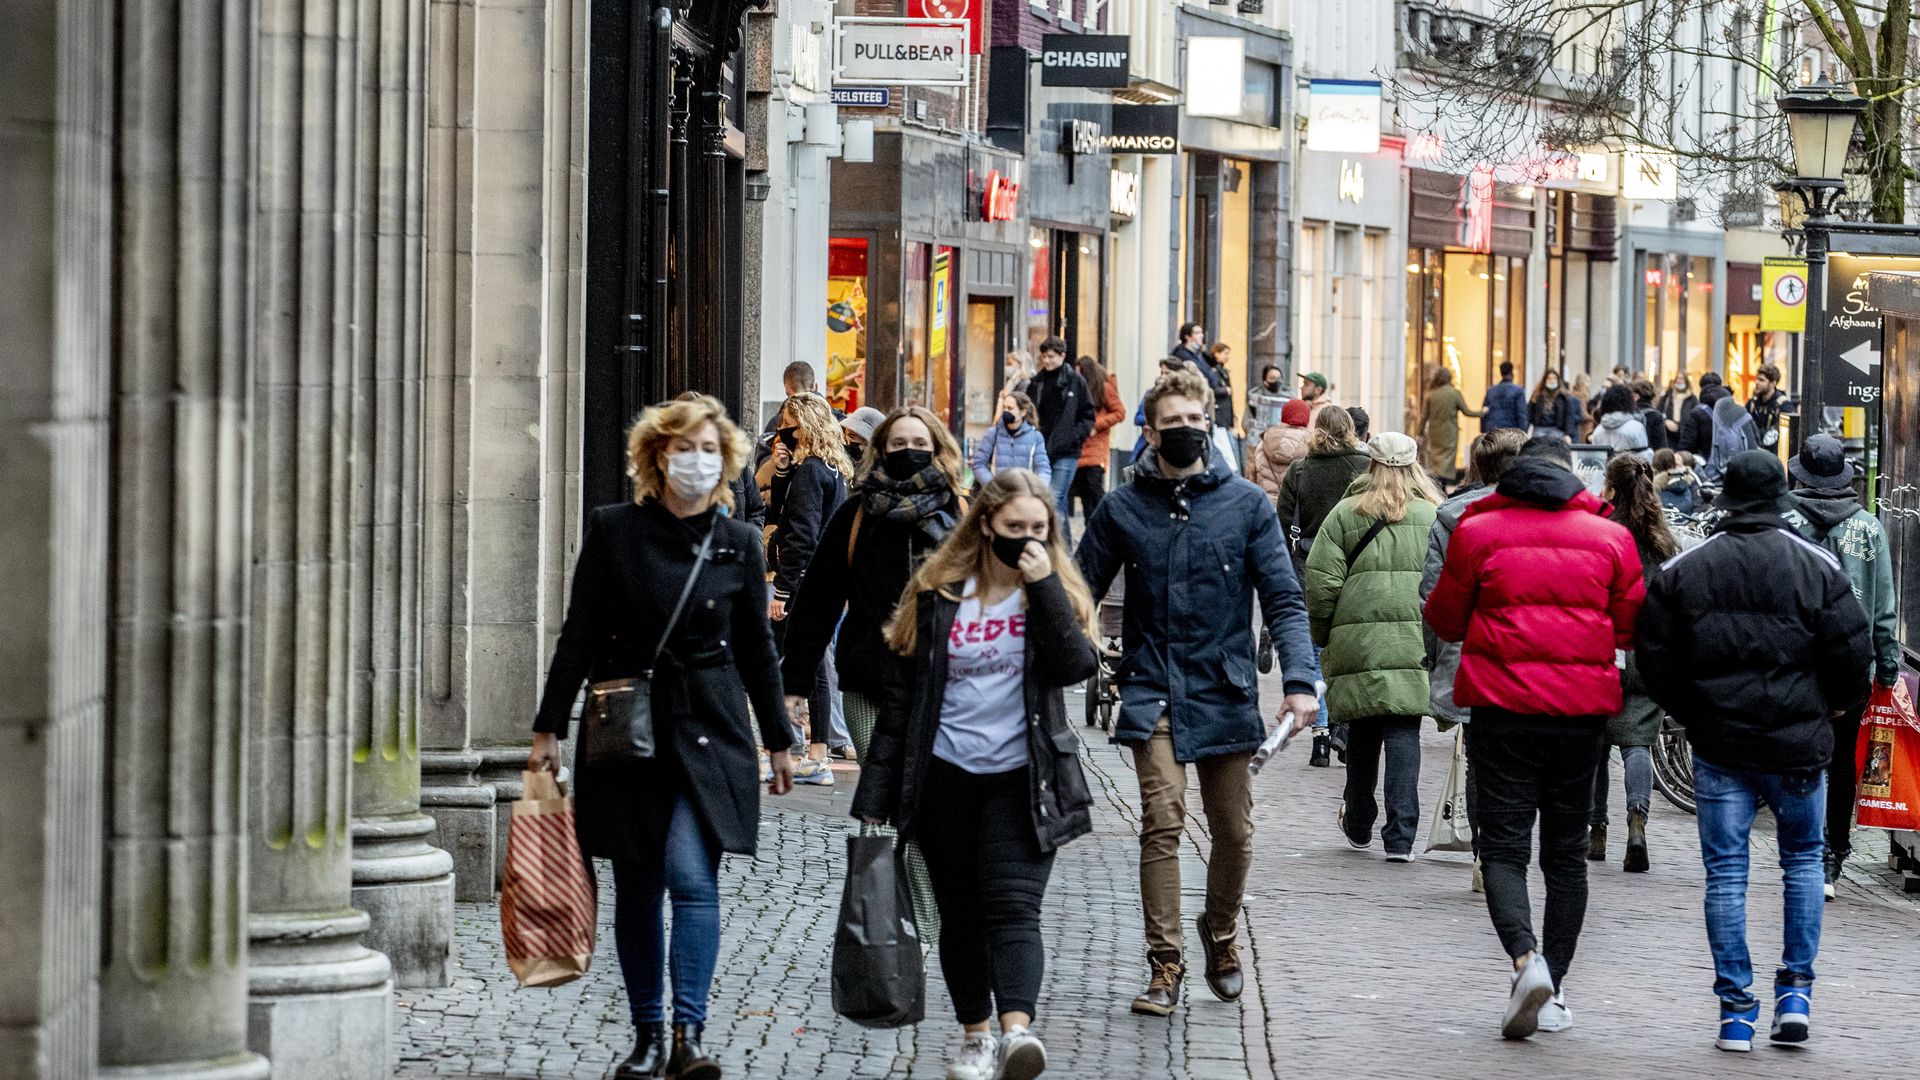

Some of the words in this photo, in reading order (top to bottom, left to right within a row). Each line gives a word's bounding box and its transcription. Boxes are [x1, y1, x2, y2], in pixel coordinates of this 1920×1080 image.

[855, 43, 954, 62] PULL&BEAR
[1043, 51, 1127, 67] CHASIN'
[1111, 135, 1175, 149] MANGO
[1829, 315, 1876, 330] Afghaans
[1843, 529, 1867, 544] ALL
